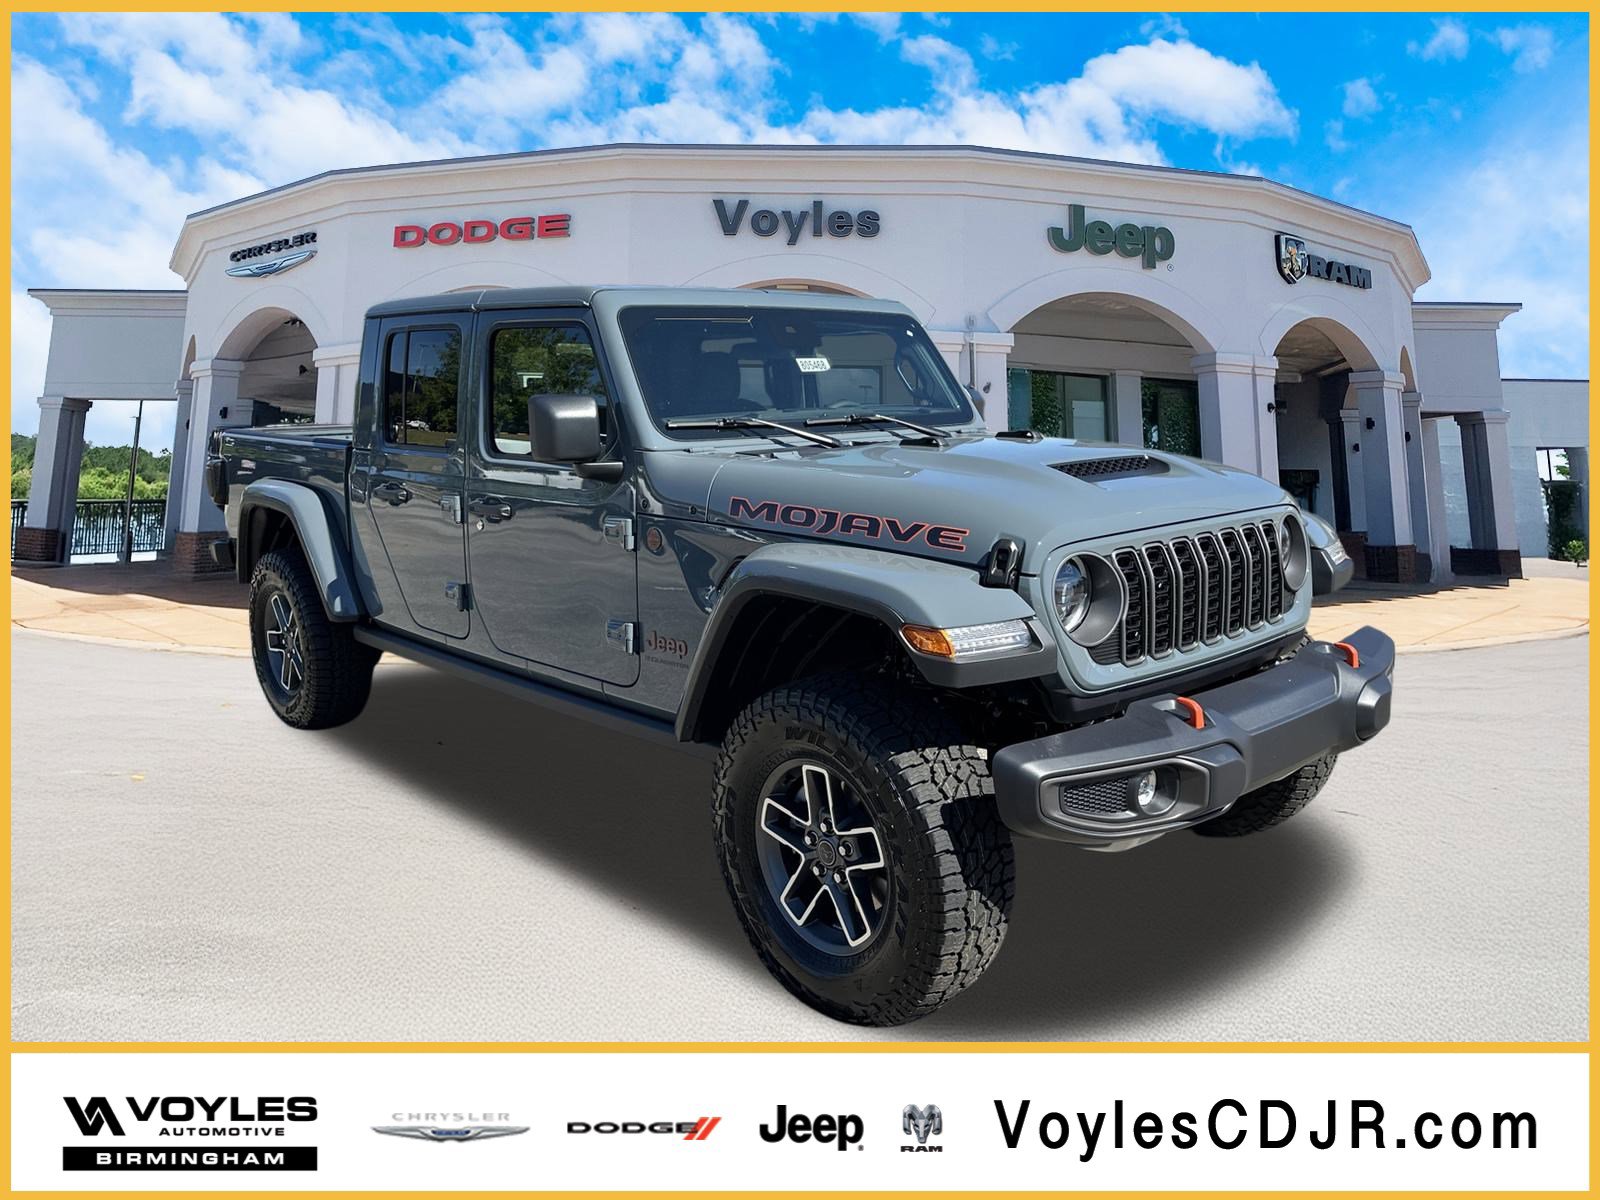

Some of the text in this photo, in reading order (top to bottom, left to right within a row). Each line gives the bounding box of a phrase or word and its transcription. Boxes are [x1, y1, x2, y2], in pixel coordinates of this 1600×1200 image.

[393, 213, 572, 249] DODGE
[713, 199, 880, 246] Voyles
[1047, 204, 1175, 270] Jeep
[230, 231, 318, 263] CHRYSLER
[1307, 256, 1373, 290] RAM
[729, 496, 970, 552] MOJAVE
[646, 630, 688, 660] Jeep
